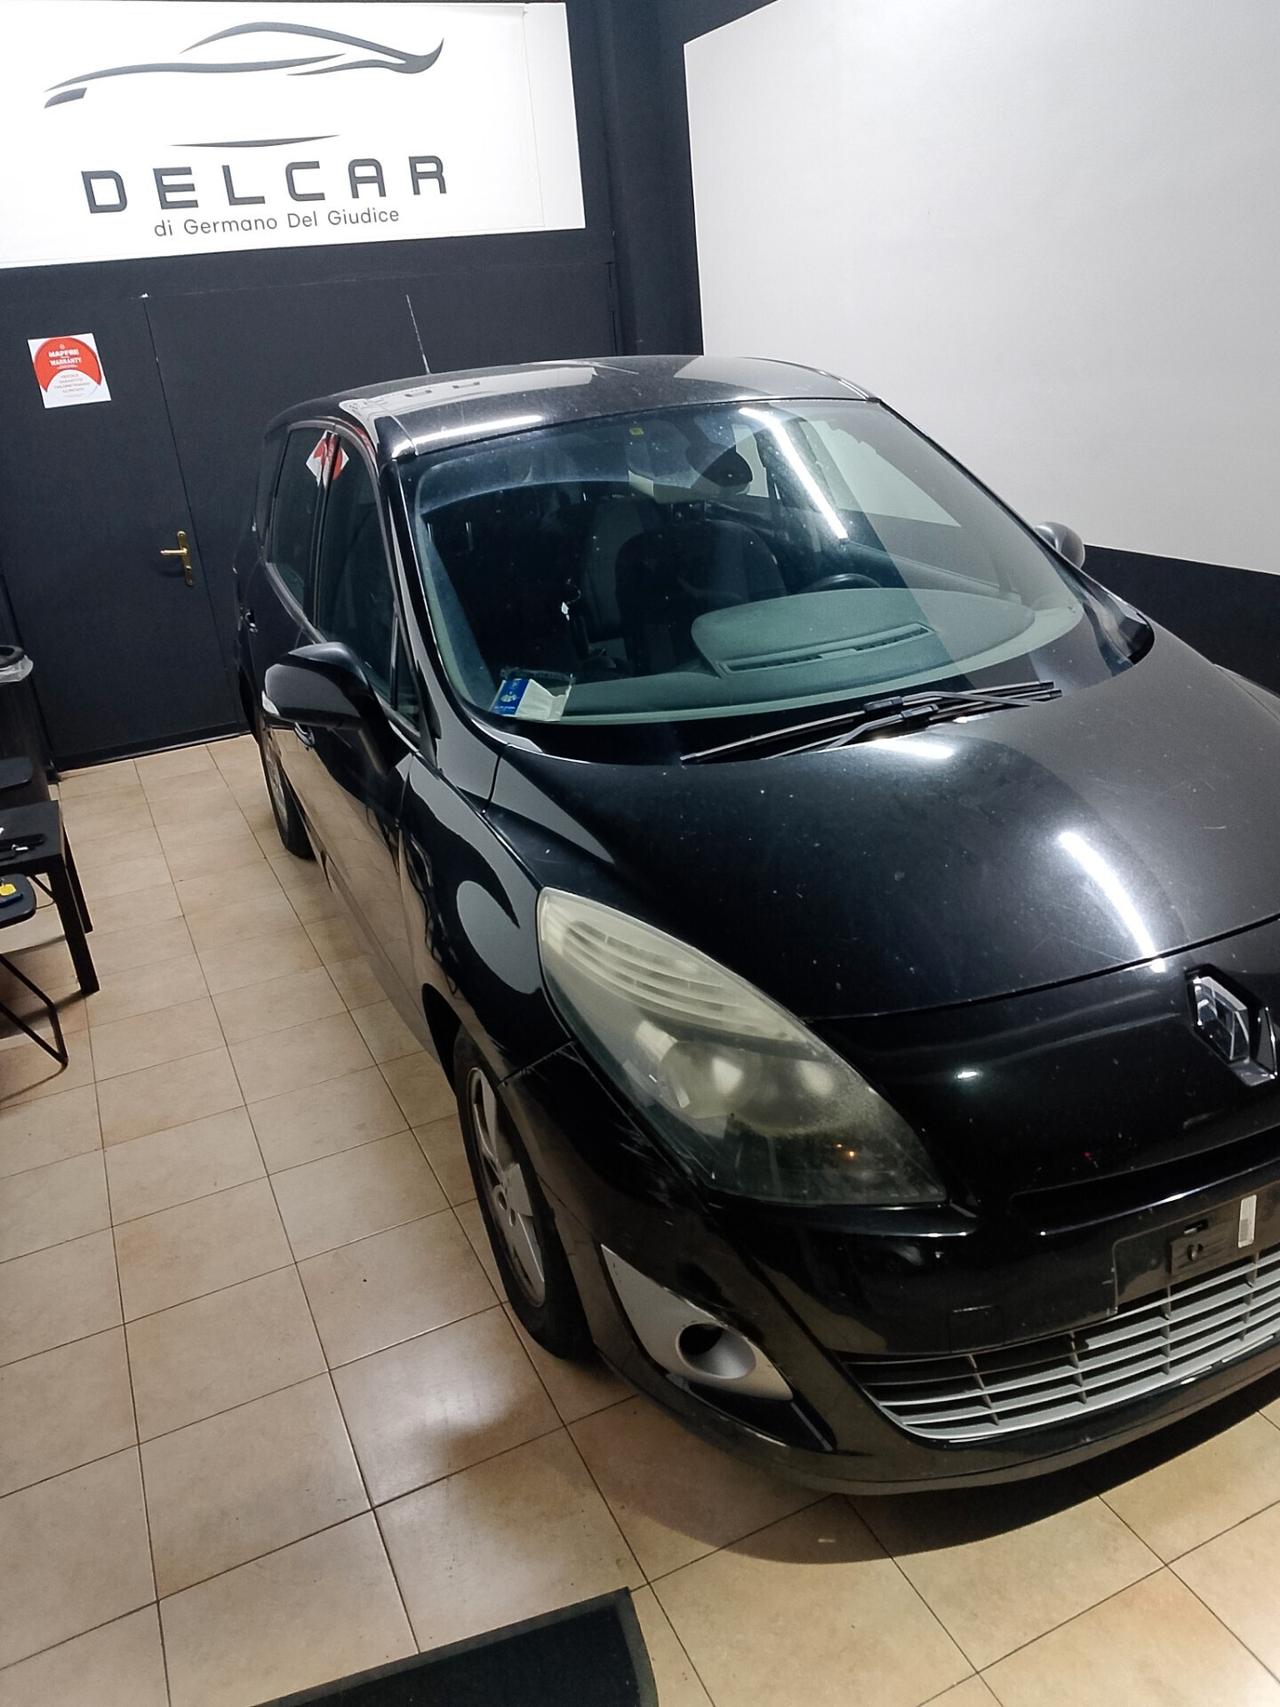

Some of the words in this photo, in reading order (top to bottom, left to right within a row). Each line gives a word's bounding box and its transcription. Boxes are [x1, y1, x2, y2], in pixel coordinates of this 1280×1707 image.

[81, 155, 447, 214] DELCAR
[154, 219, 173, 237] di
[183, 217, 278, 235] Germano
[287, 211, 318, 229] Del
[327, 207, 400, 226] Giudice
[49, 357, 82, 366] WARRANTY
